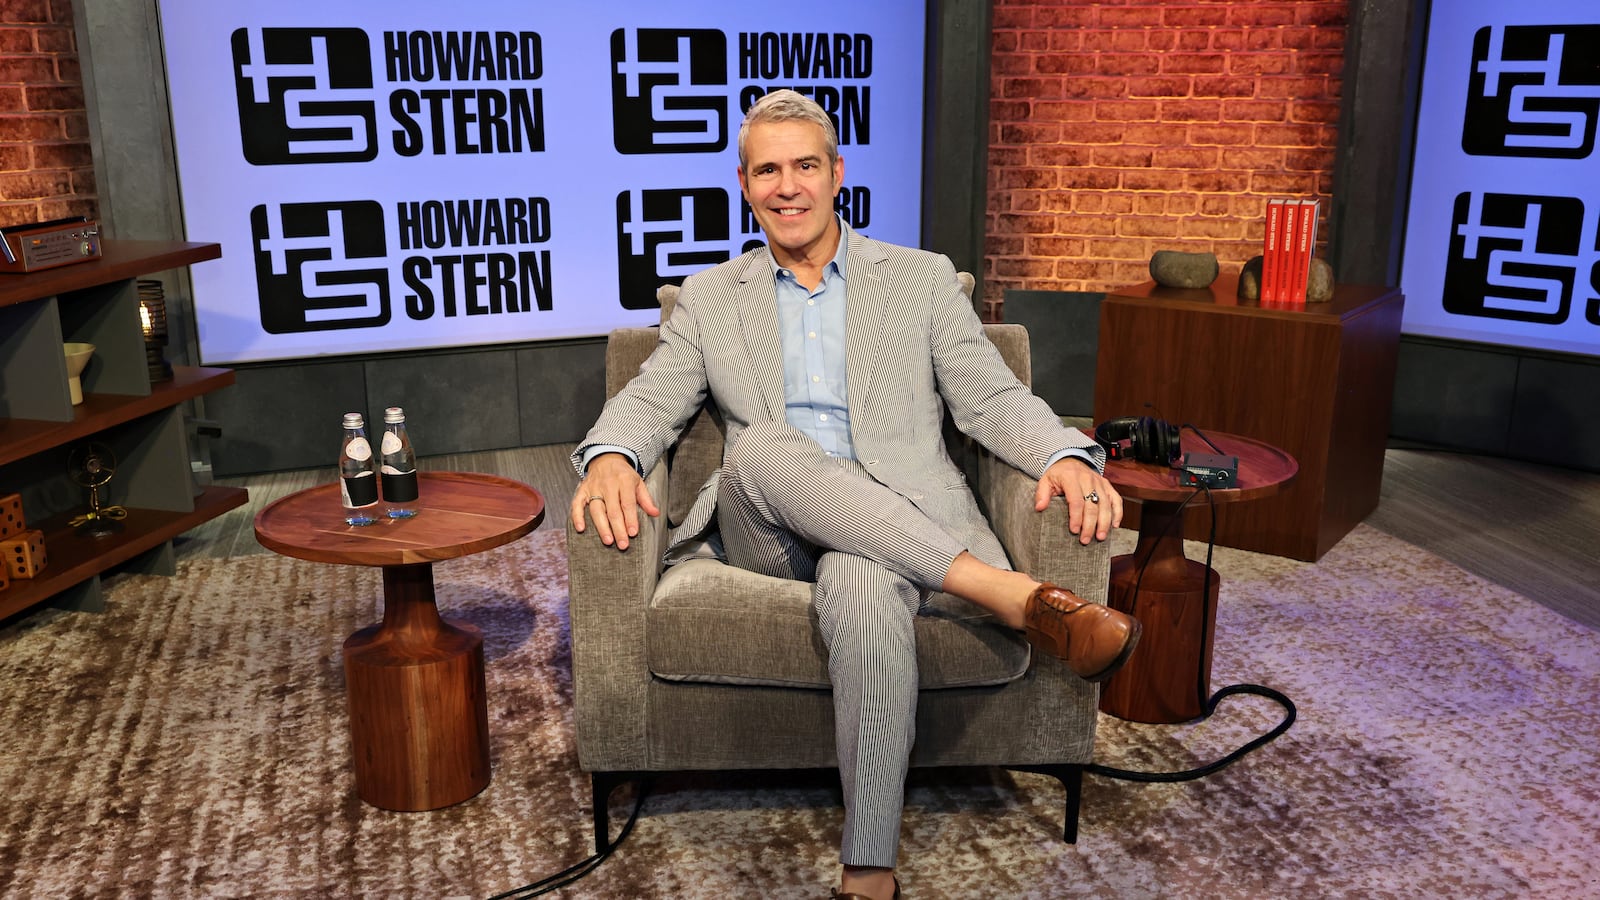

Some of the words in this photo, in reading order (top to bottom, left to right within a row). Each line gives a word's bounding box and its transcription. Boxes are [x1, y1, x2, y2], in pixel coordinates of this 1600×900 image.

[383, 30, 543, 82] HOWARD
[739, 32, 872, 79] HOWARD
[389, 88, 545, 157] STERN
[397, 196, 551, 249] HOWARD
[741, 186, 871, 234] HRD
[402, 250, 553, 320] STERN
